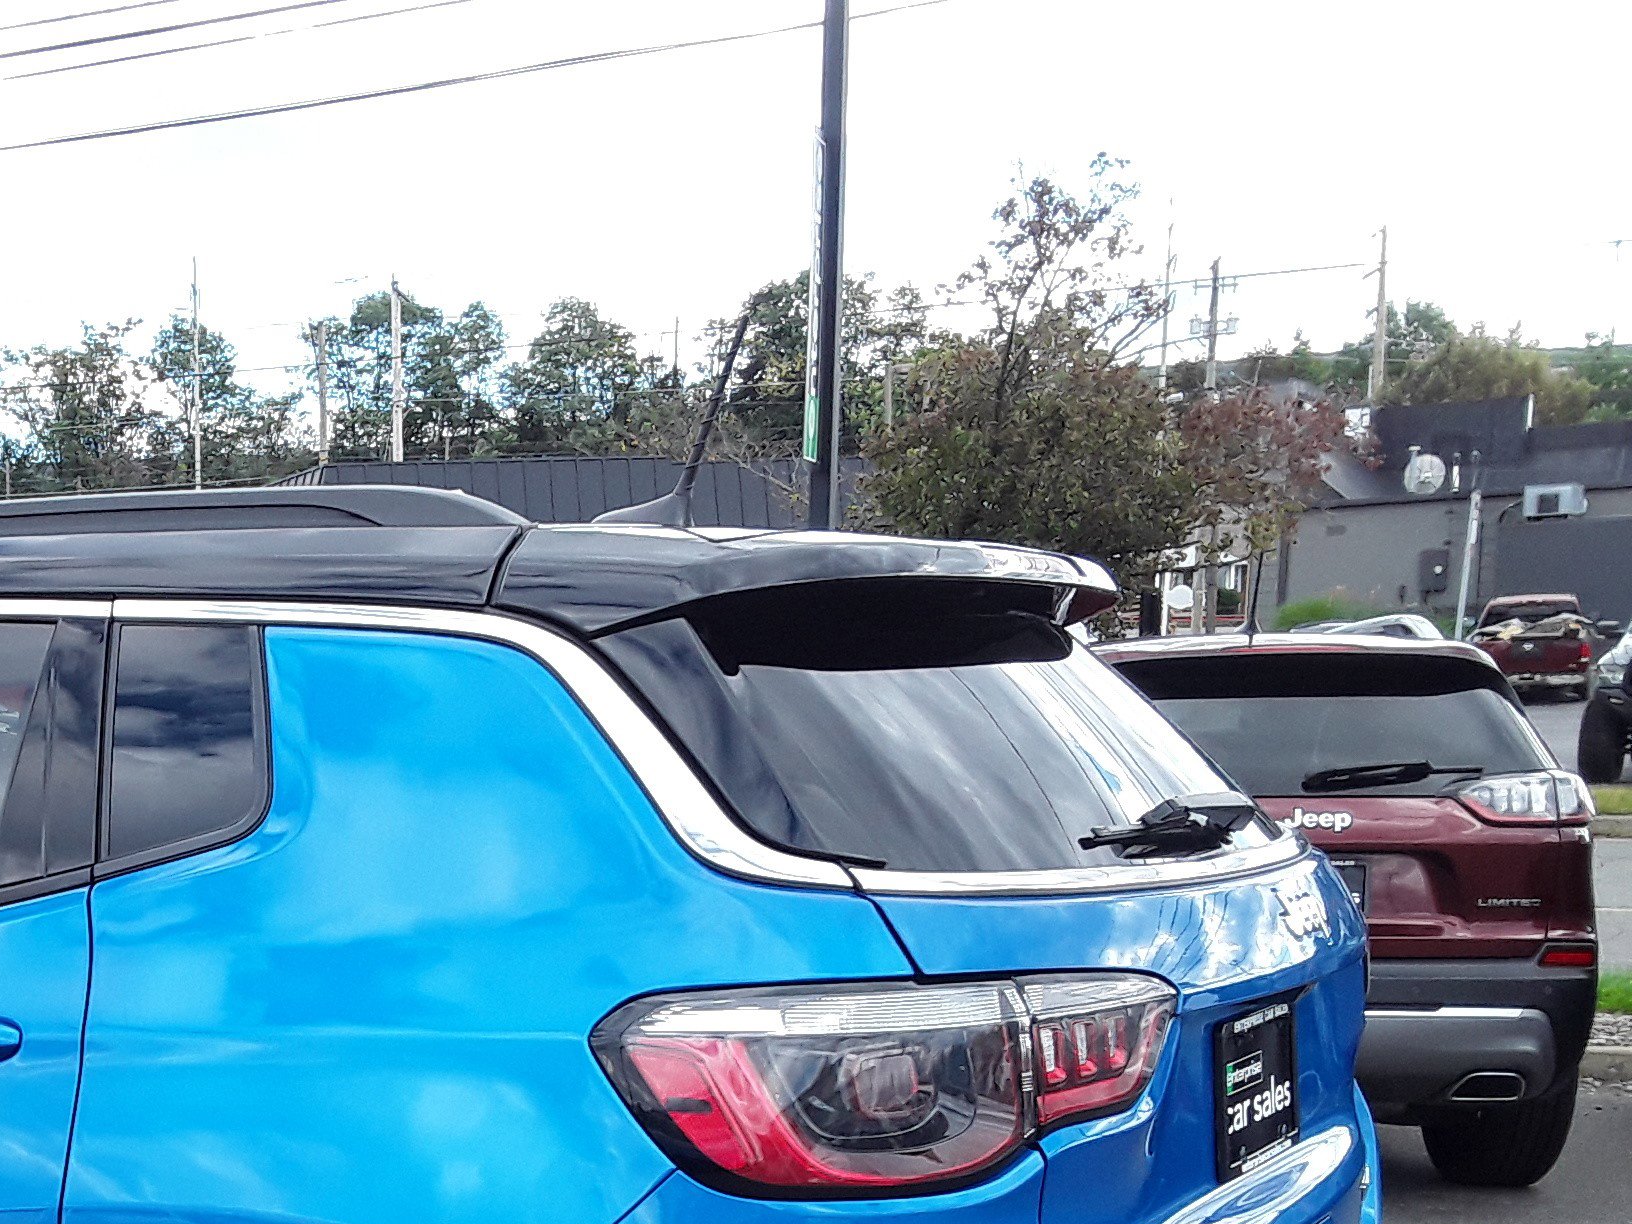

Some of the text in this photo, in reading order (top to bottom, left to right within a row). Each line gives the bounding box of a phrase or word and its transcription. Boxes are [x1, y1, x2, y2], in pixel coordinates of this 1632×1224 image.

[1286, 808, 1353, 832] Jeep
[1477, 898, 1541, 907] LIMITED
[1253, 1074, 1291, 1122] sales
